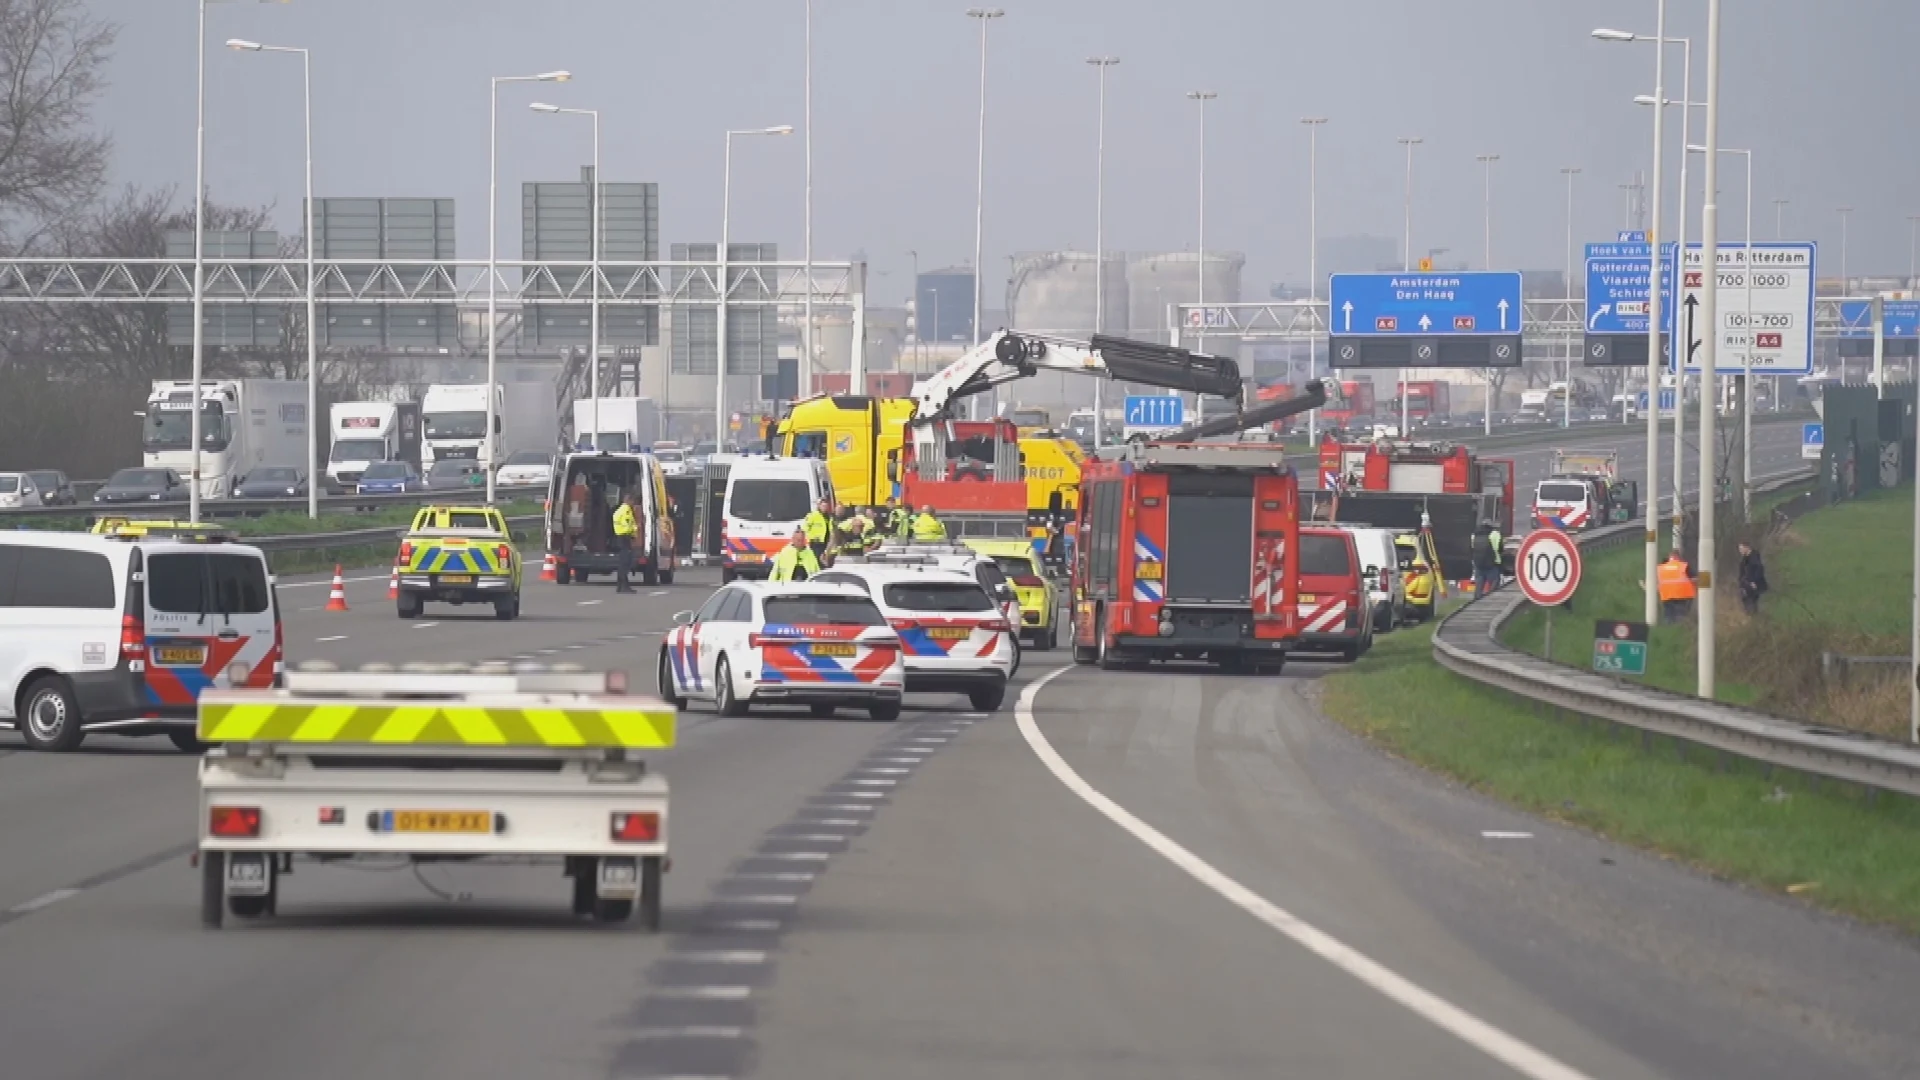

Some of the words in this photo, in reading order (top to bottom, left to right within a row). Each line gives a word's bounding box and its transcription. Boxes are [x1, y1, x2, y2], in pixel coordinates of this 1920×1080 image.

[1591, 246, 1618, 255] Hoek
[1684, 253, 1731, 261] Hans
[1591, 263, 1650, 272] Rotterdam
[1390, 278, 1460, 288] Amsterdam
[1396, 291, 1420, 300] Den
[1424, 291, 1455, 301] Haag
[1609, 288, 1670, 298] Schiedm
[1377, 320, 1395, 328] A4
[1456, 319, 1472, 327] A4
[1759, 336, 1779, 346] A4
[1527, 552, 1569, 582] 100
[153, 613, 188, 621] POLITIE
[777, 627, 815, 635] POLITIE
